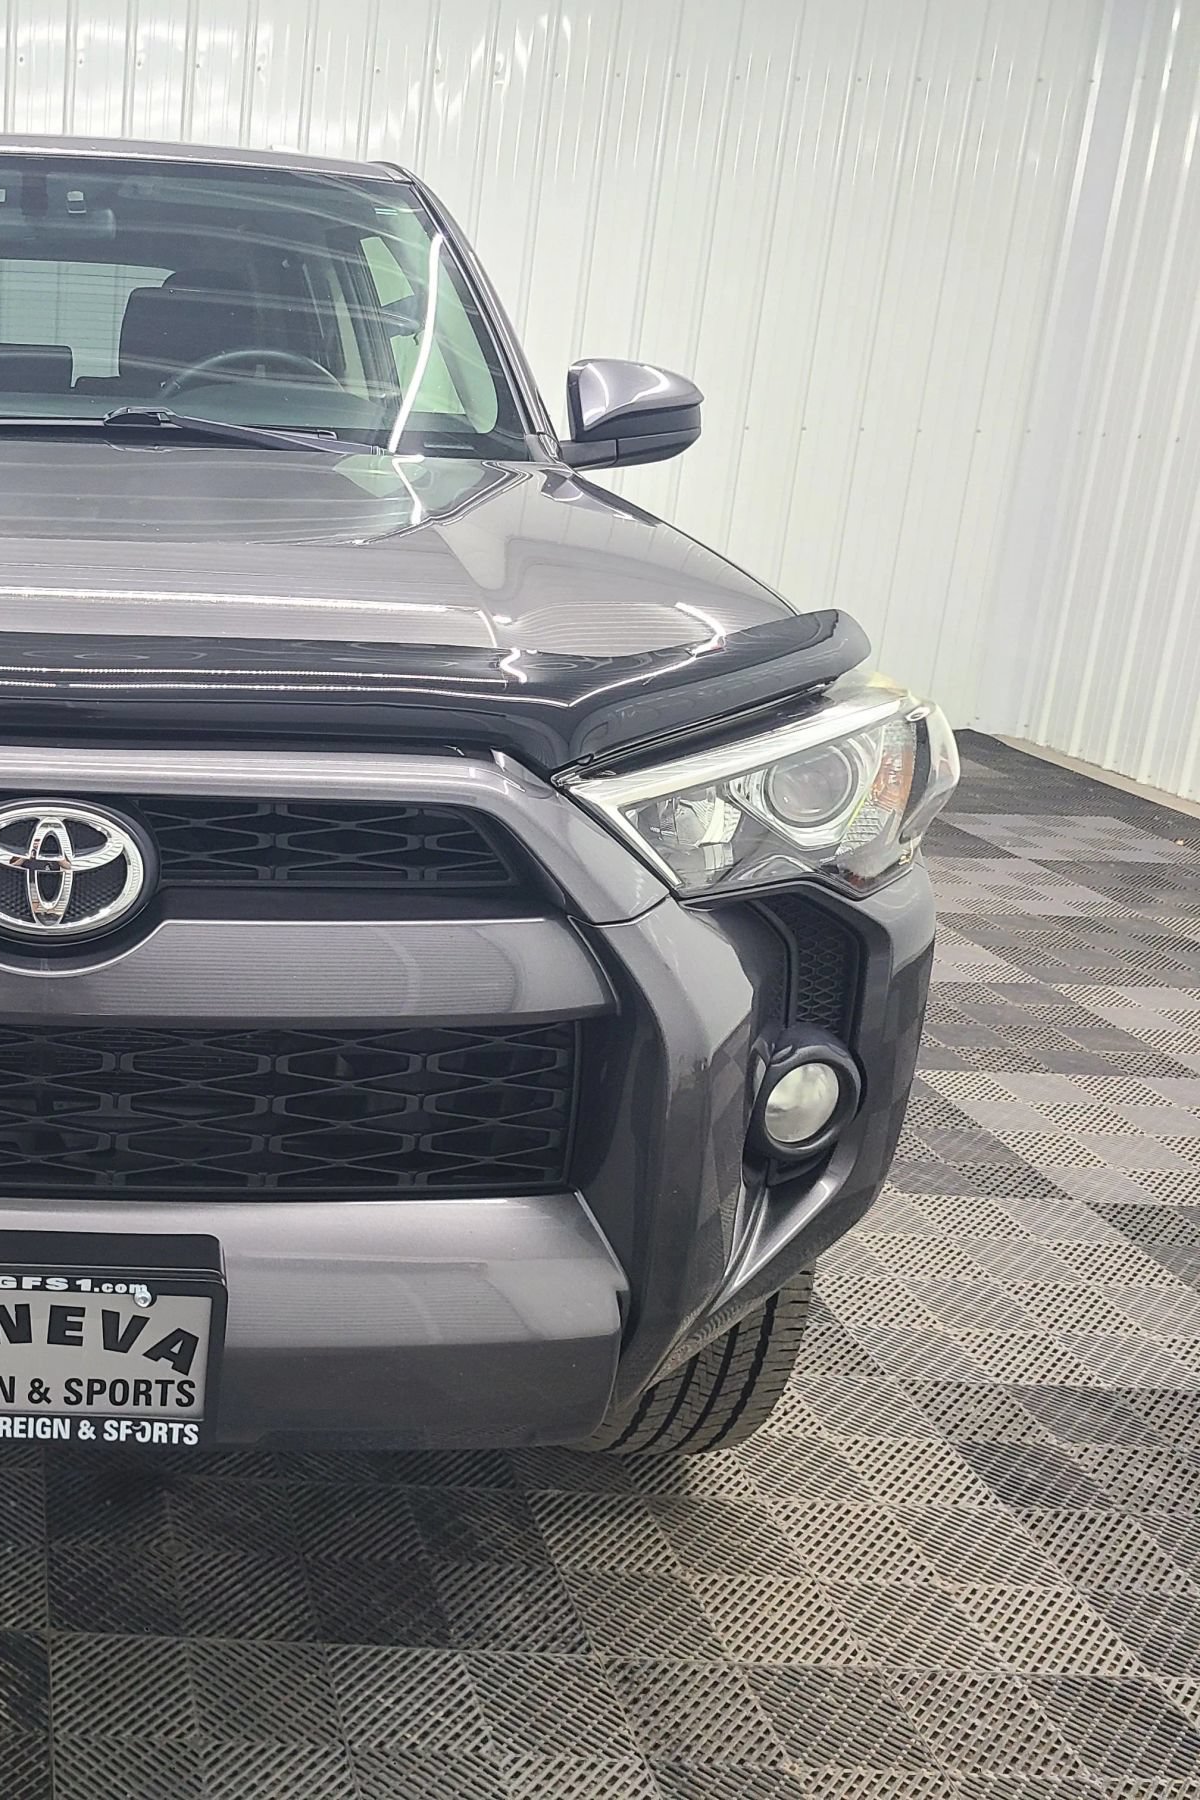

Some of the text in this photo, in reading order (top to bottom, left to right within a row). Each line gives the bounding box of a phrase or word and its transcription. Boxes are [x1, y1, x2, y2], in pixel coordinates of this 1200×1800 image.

[27, 1377, 52, 1405] &
[63, 1377, 196, 1408] SPORTS
[77, 1419, 97, 1441] &
